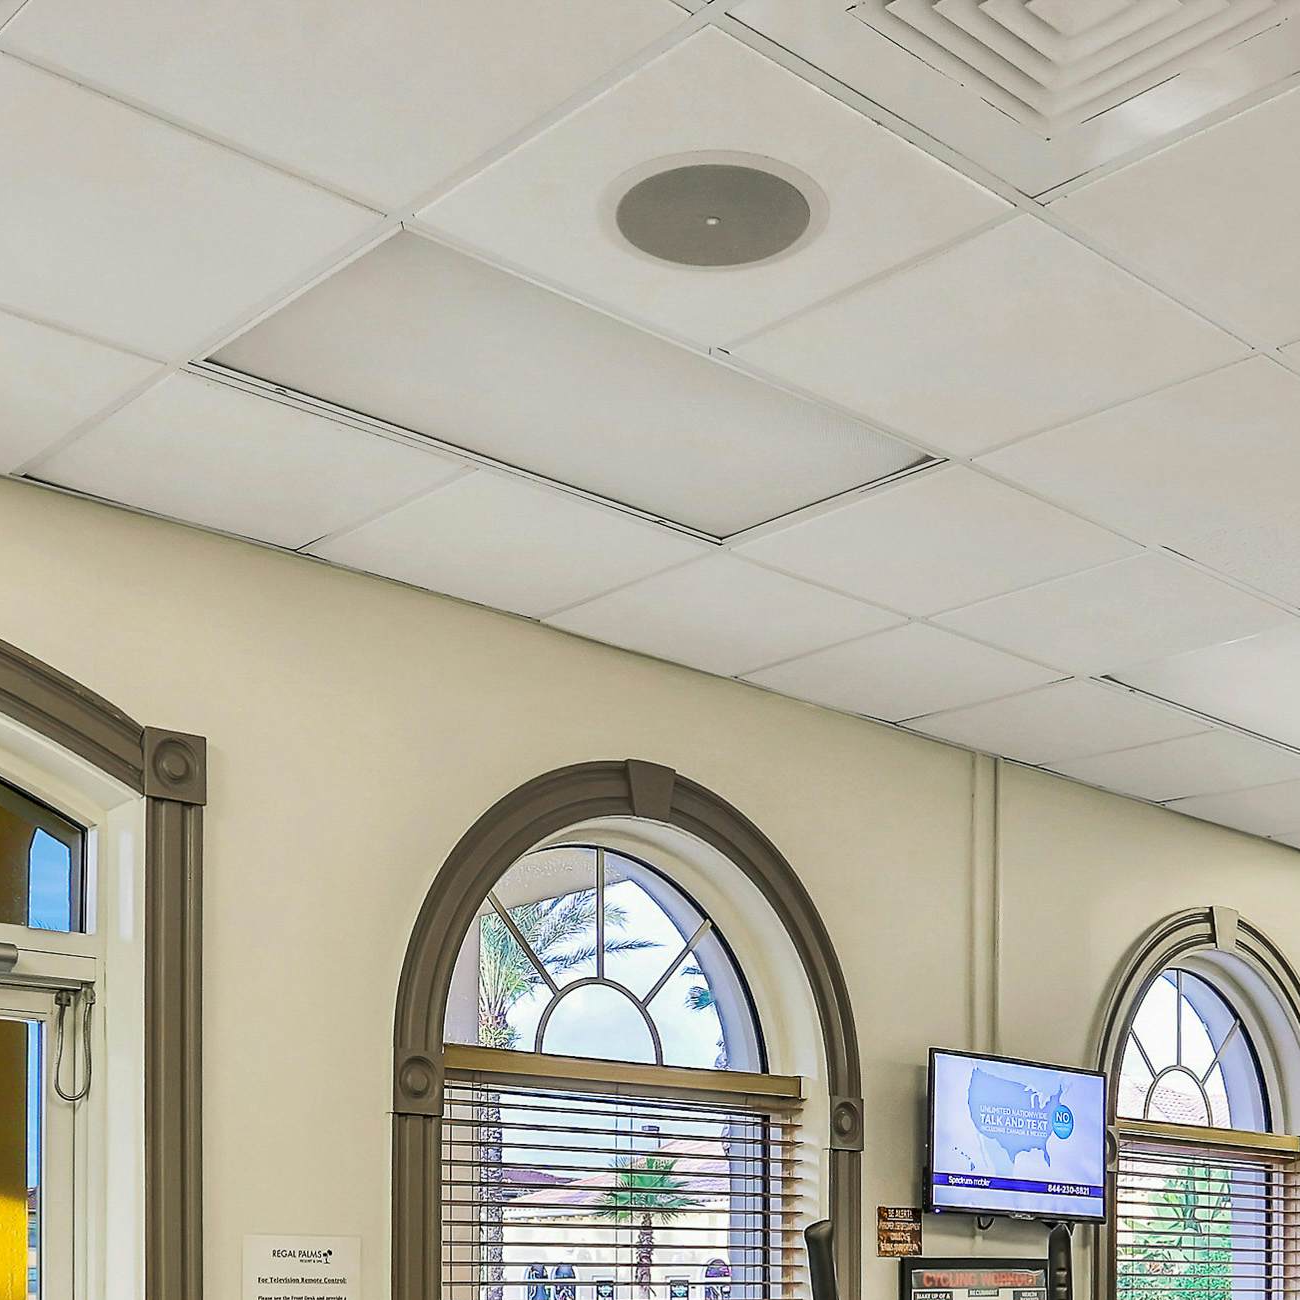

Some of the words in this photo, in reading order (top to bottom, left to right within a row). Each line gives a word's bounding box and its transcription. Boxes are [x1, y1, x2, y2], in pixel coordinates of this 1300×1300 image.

[980, 1105, 1011, 1115] UNLIMITED
[980, 1113, 1004, 1127] TALK
[1004, 1116, 1025, 1128] AND
[1026, 1119, 1049, 1131] TEXT
[1055, 1111, 1071, 1124] NO
[272, 1249, 296, 1258] REGAL
[298, 1250, 322, 1259] PALMS
[300, 1277, 323, 1285] Remote
[923, 1271, 977, 1288] CYCLING
